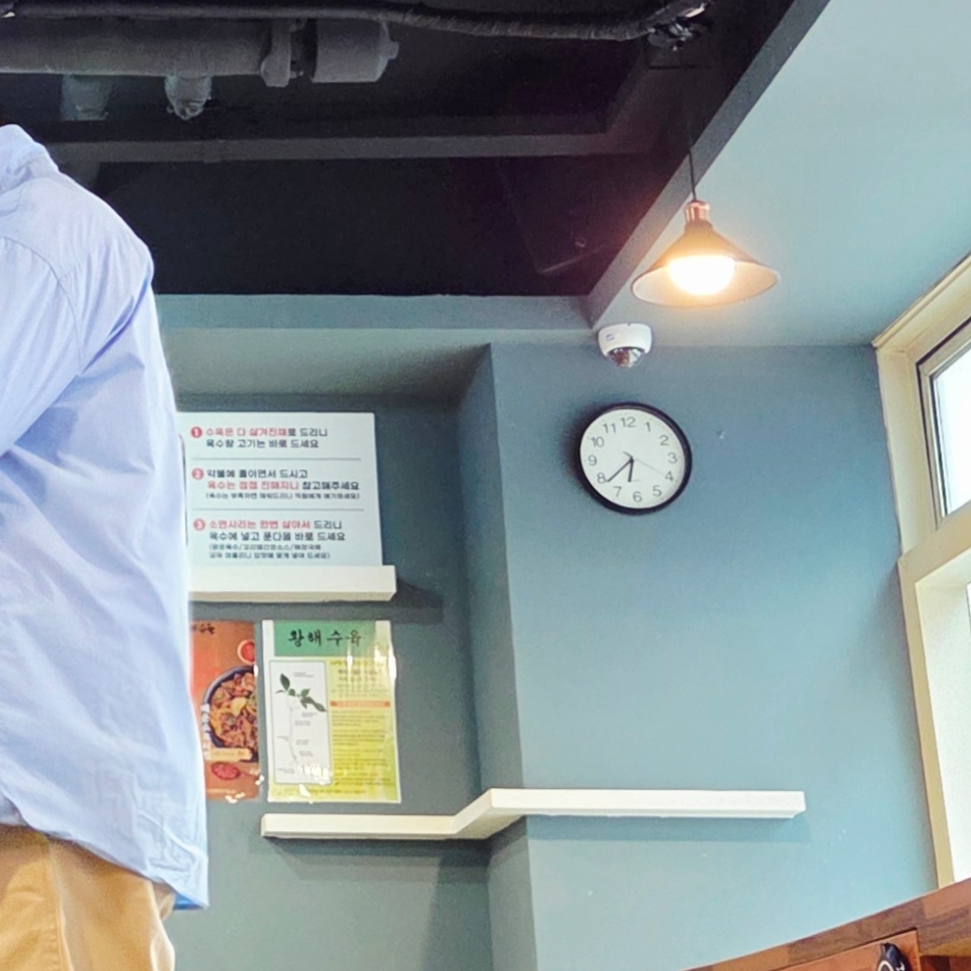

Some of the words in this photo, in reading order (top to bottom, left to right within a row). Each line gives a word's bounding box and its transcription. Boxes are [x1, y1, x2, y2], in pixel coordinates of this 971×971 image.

[621, 416, 636, 427] 12
[645, 422, 651, 432] 1
[300, 428, 328, 437] 드리니
[603, 423, 616, 434] 11
[237, 439, 265, 448] 고기는
[269, 439, 287, 448] 바로
[291, 439, 319, 448] 드세요
[591, 436, 604, 447] 10
[659, 435, 669, 446] 2
[588, 455, 597, 466] 9
[668, 452, 677, 464] 3
[279, 469, 308, 478] 드시고
[597, 472, 607, 484] 8
[665, 471, 674, 482] 4
[613, 486, 622, 497] 7
[633, 491, 642, 502] 6
[652, 485, 662, 497] 5
[314, 520, 342, 529] 드리니
[294, 531, 314, 541] 바로
[317, 531, 345, 541] 드세요
